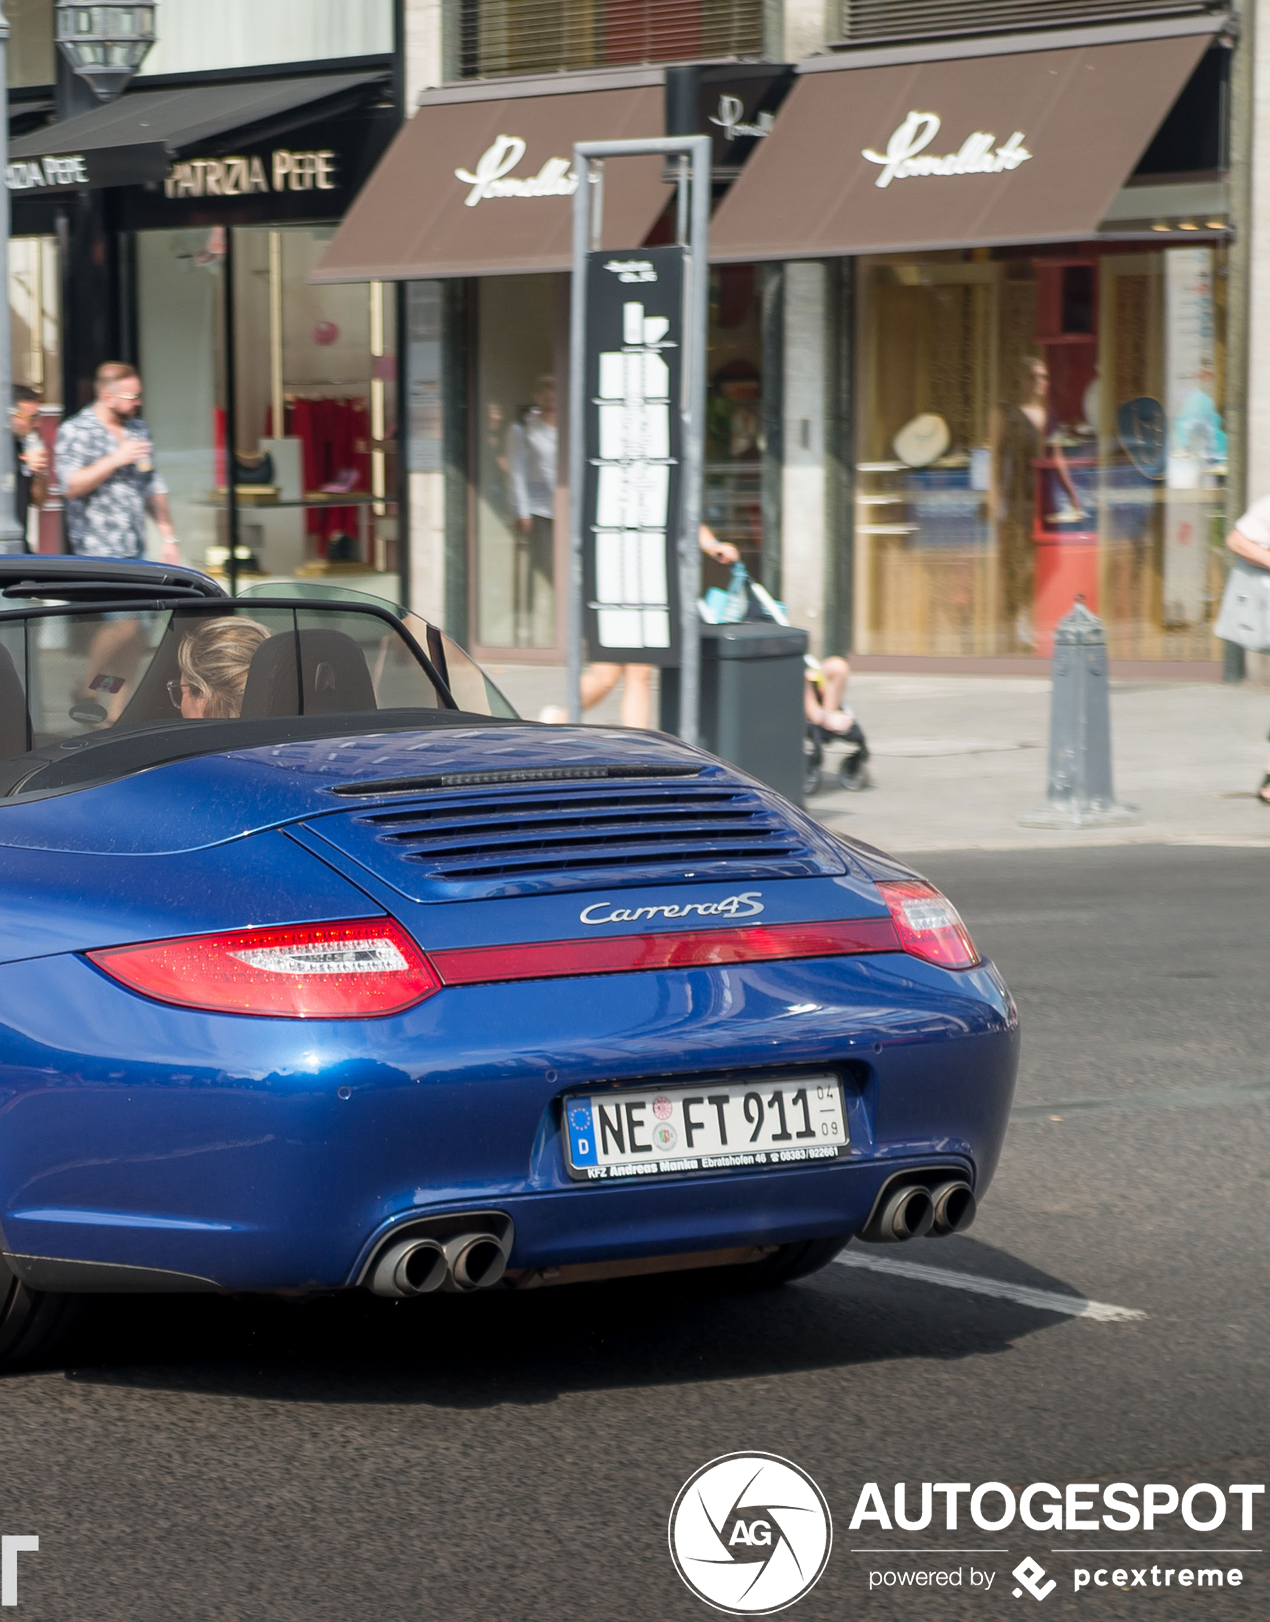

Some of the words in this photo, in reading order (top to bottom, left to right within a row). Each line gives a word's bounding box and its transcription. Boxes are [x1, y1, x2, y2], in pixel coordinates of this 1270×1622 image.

[861, 111, 1033, 188] Pomellato
[272, 151, 336, 192] PEPE
[816, 1085, 833, 1100] 04
[578, 1138, 589, 1155] D
[598, 1101, 652, 1155] NE
[682, 1095, 730, 1148] FT
[743, 1088, 816, 1142] 911
[821, 1121, 838, 1136] 09
[587, 1168, 608, 1179] KFZ
[609, 1161, 658, 1177] Andreas
